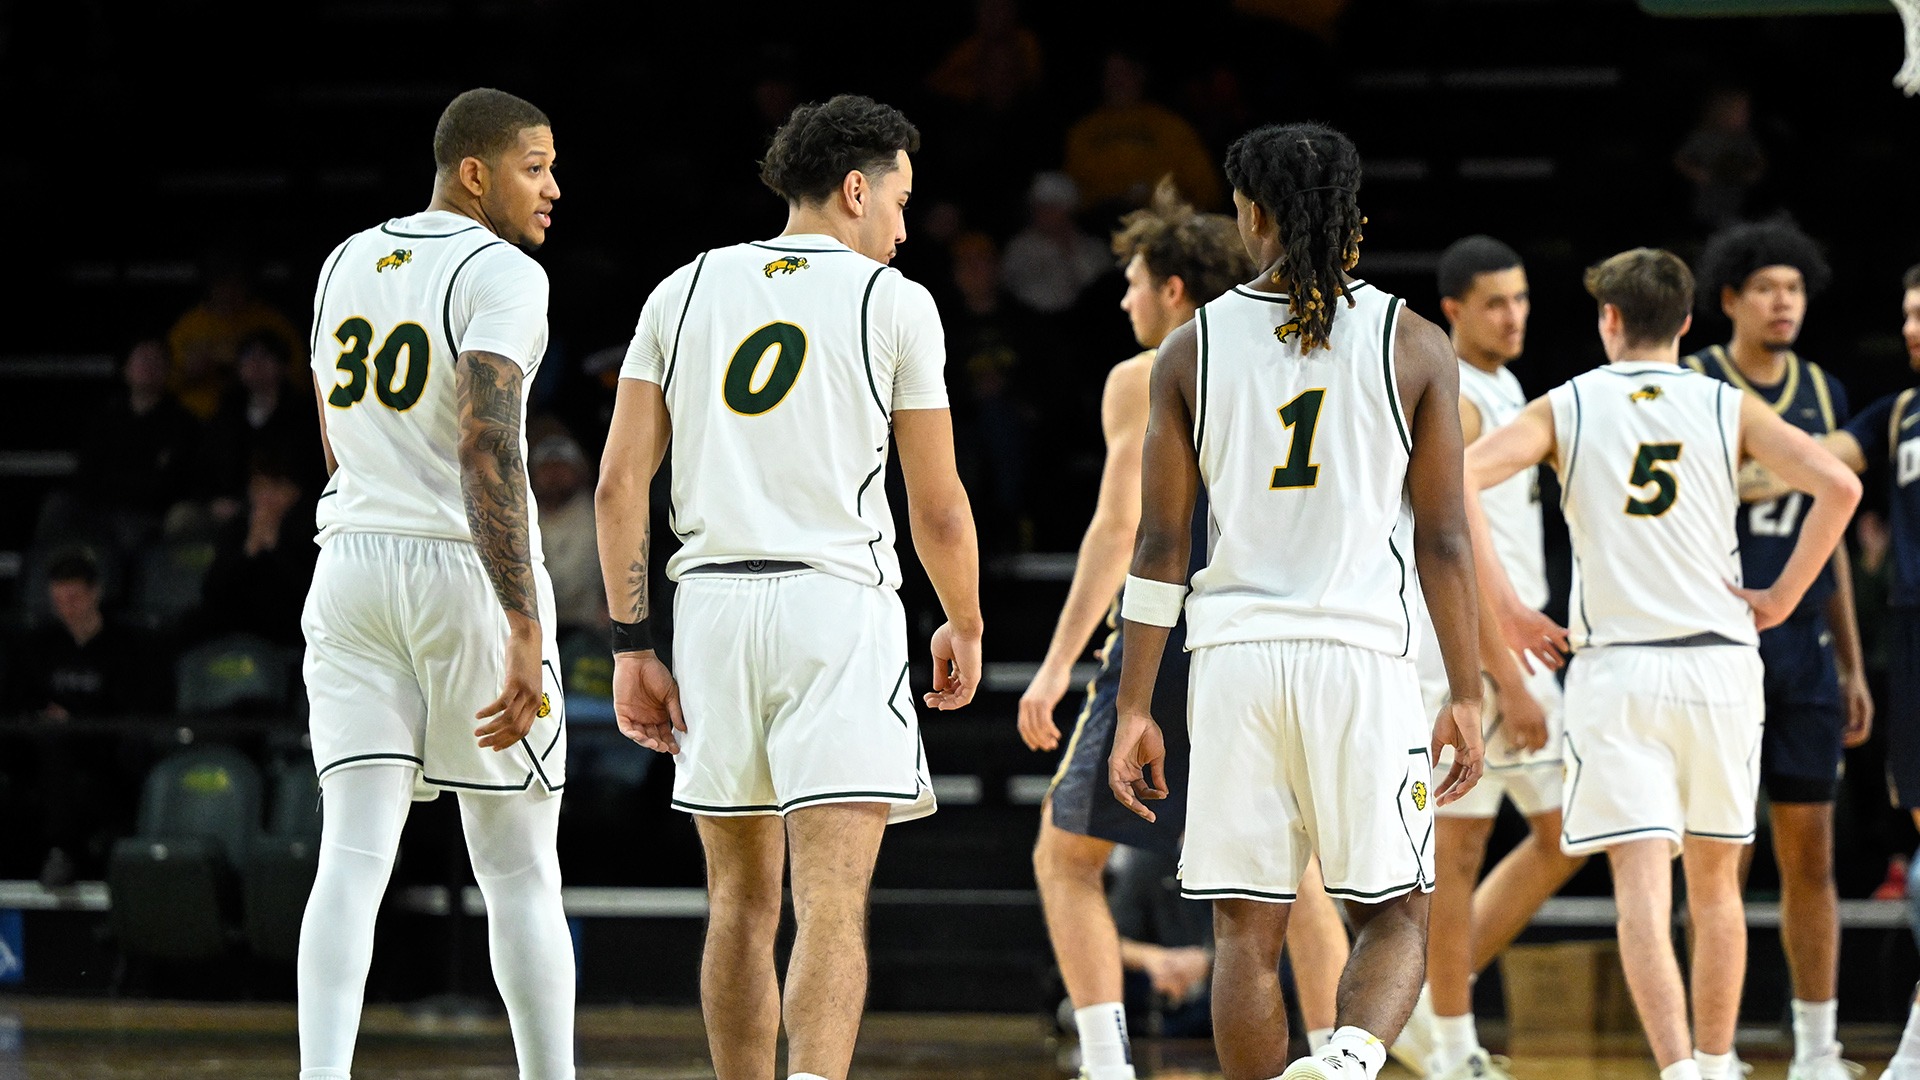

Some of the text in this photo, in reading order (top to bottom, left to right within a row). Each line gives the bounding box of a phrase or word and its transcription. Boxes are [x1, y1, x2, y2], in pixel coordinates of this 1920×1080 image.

[328, 315, 432, 413] 30
[722, 320, 809, 416] 0
[1269, 387, 1327, 490] 1
[1623, 441, 1683, 518] 5
